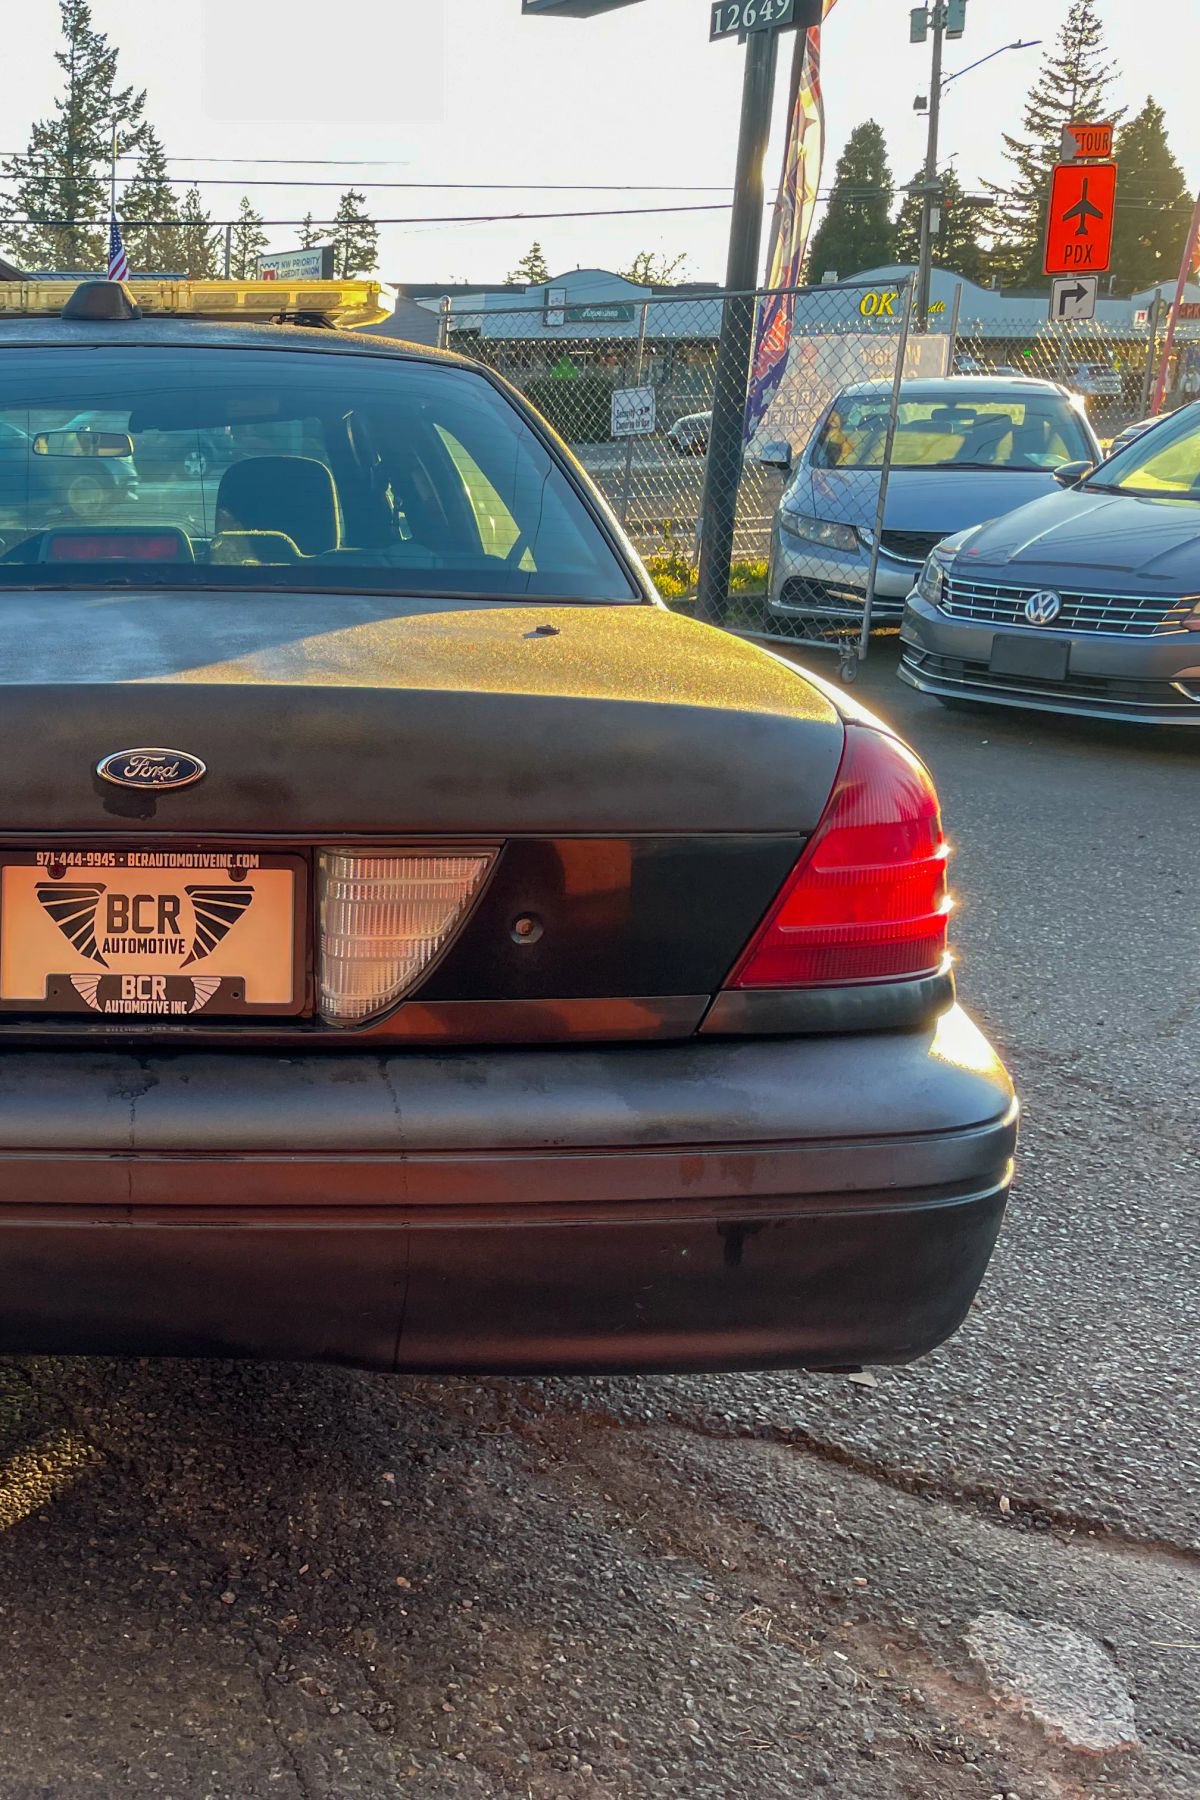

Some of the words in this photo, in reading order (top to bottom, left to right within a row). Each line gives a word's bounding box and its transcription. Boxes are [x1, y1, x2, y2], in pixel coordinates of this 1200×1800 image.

[712, 0, 791, 35] 12649
[281, 260, 292, 269] NW
[292, 256, 320, 267] PRIORITY
[1064, 244, 1093, 264] PDX
[281, 268, 300, 278] CREDIT
[300, 266, 320, 276] UNION
[859, 292, 897, 317] OK
[123, 755, 179, 778] Ford
[36, 851, 116, 867] 971-444-9945
[127, 852, 259, 868] BCRAUTOMOTIVEINC.COM
[106, 894, 181, 935] BCR
[102, 938, 185, 955] AUTOMOTIVE
[121, 975, 167, 1000] BCR
[104, 1000, 170, 1014] AUTOMOTIVE
[170, 1000, 188, 1014] INC
